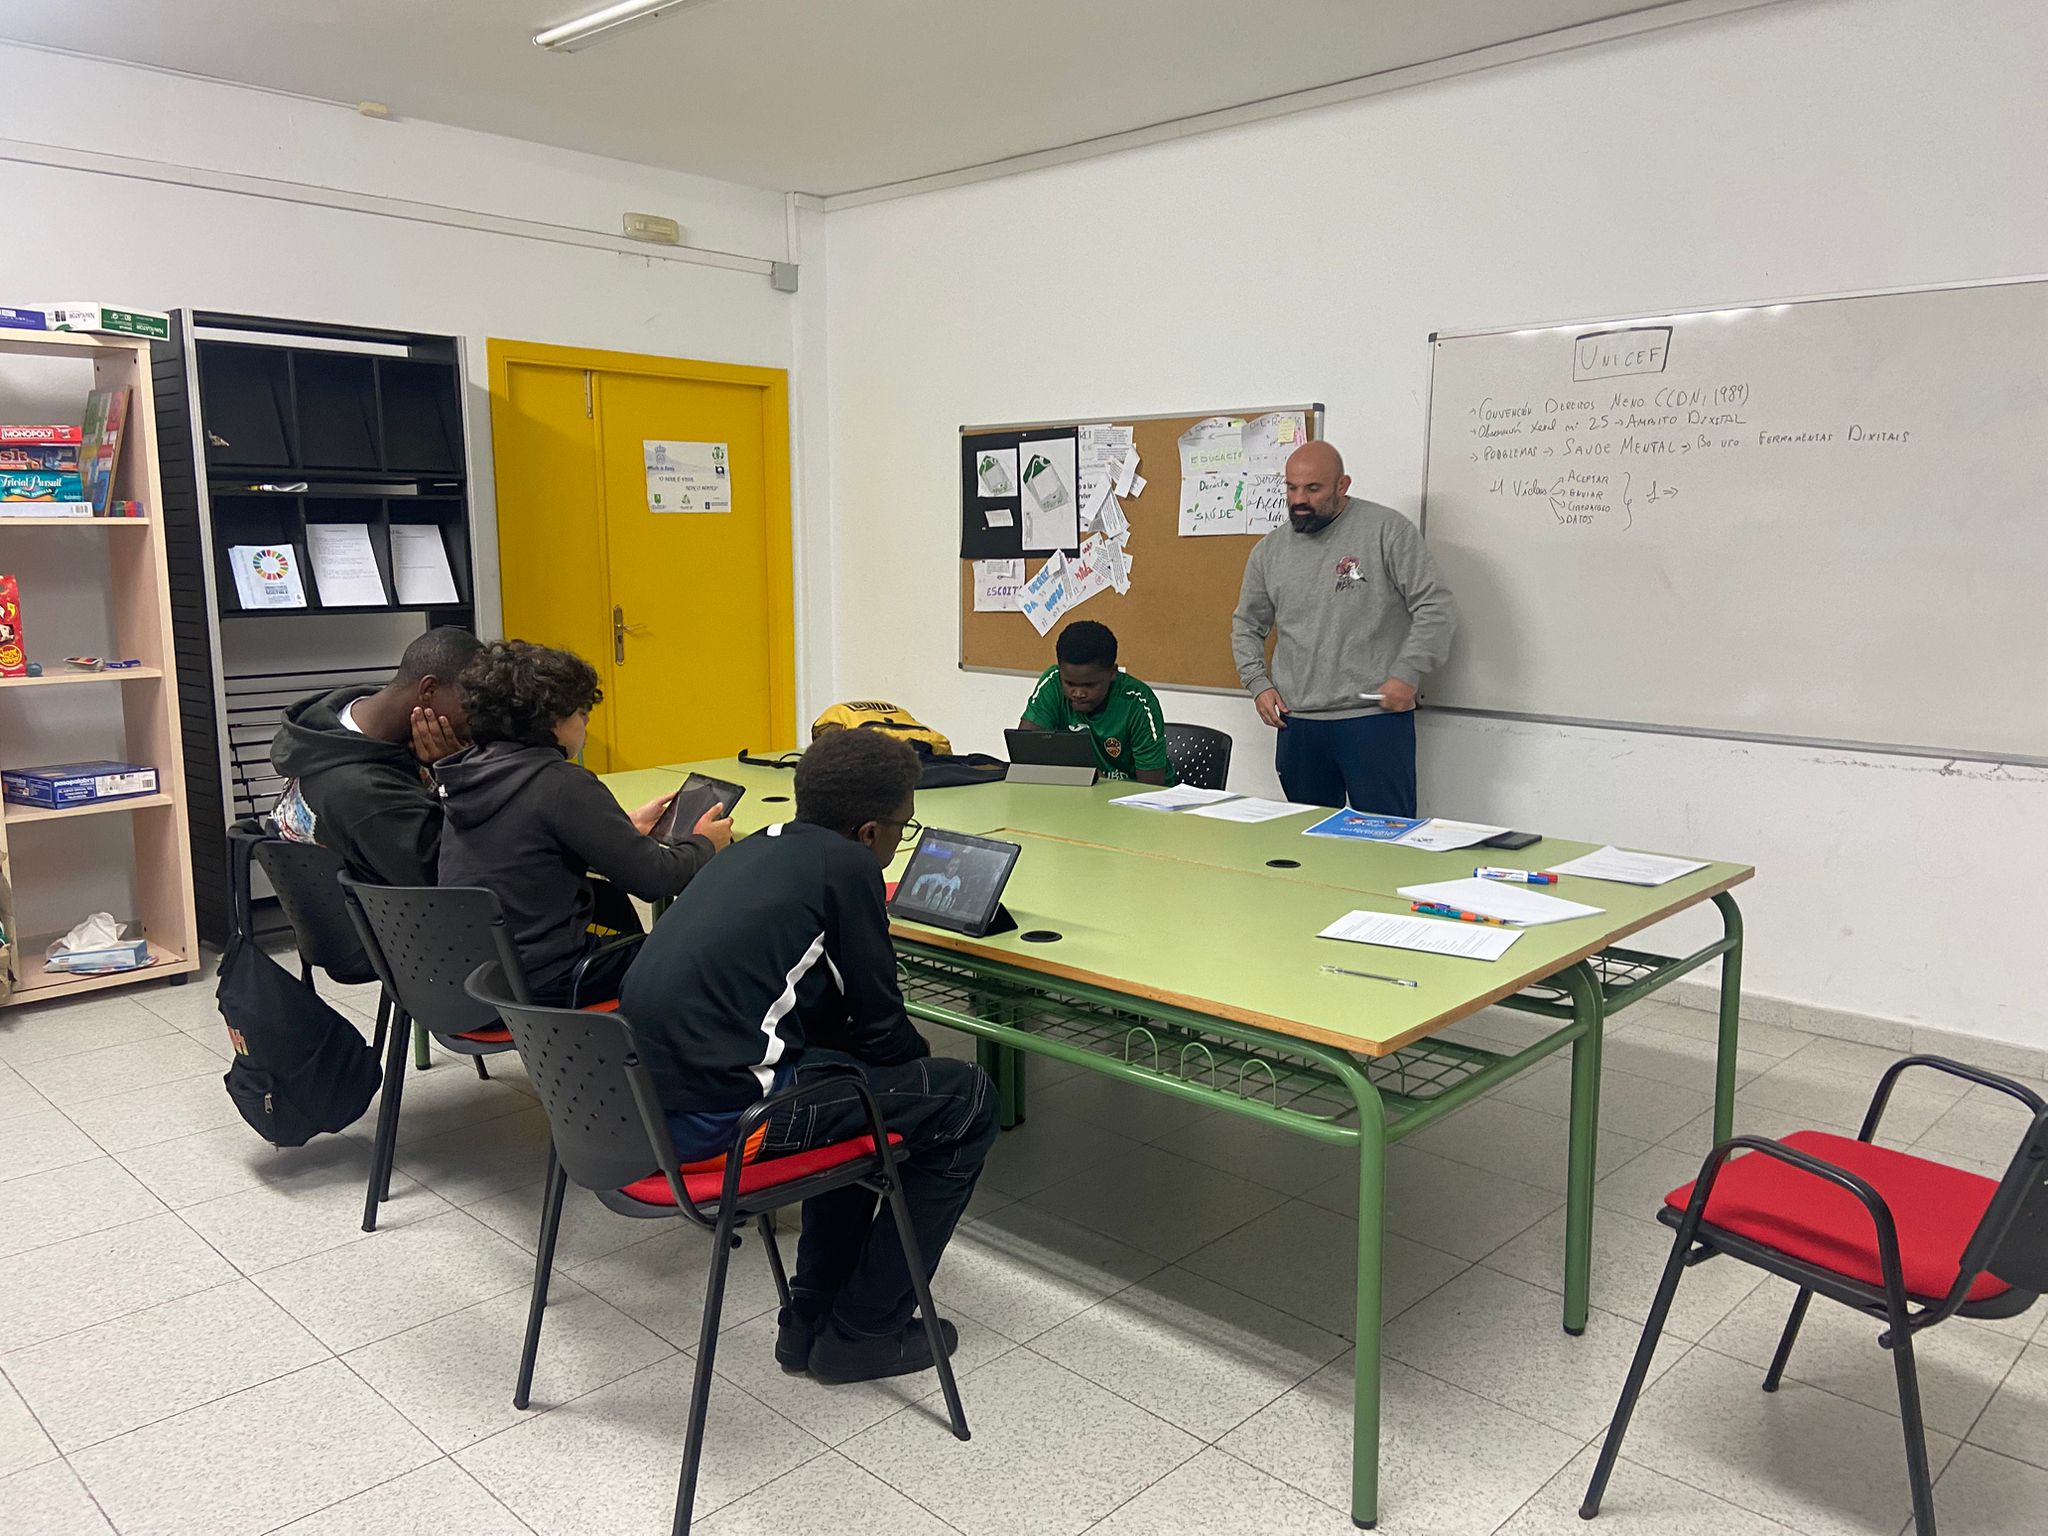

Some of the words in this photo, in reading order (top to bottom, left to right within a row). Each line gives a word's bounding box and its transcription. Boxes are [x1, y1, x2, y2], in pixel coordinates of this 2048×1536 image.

[1589, 415, 1609, 431] 25
[4, 429, 52, 438] MONOPOLY
[27, 474, 62, 491] Pursuit
[1566, 515, 1594, 525] DATOS
[986, 585, 1022, 597] ESCOIT
